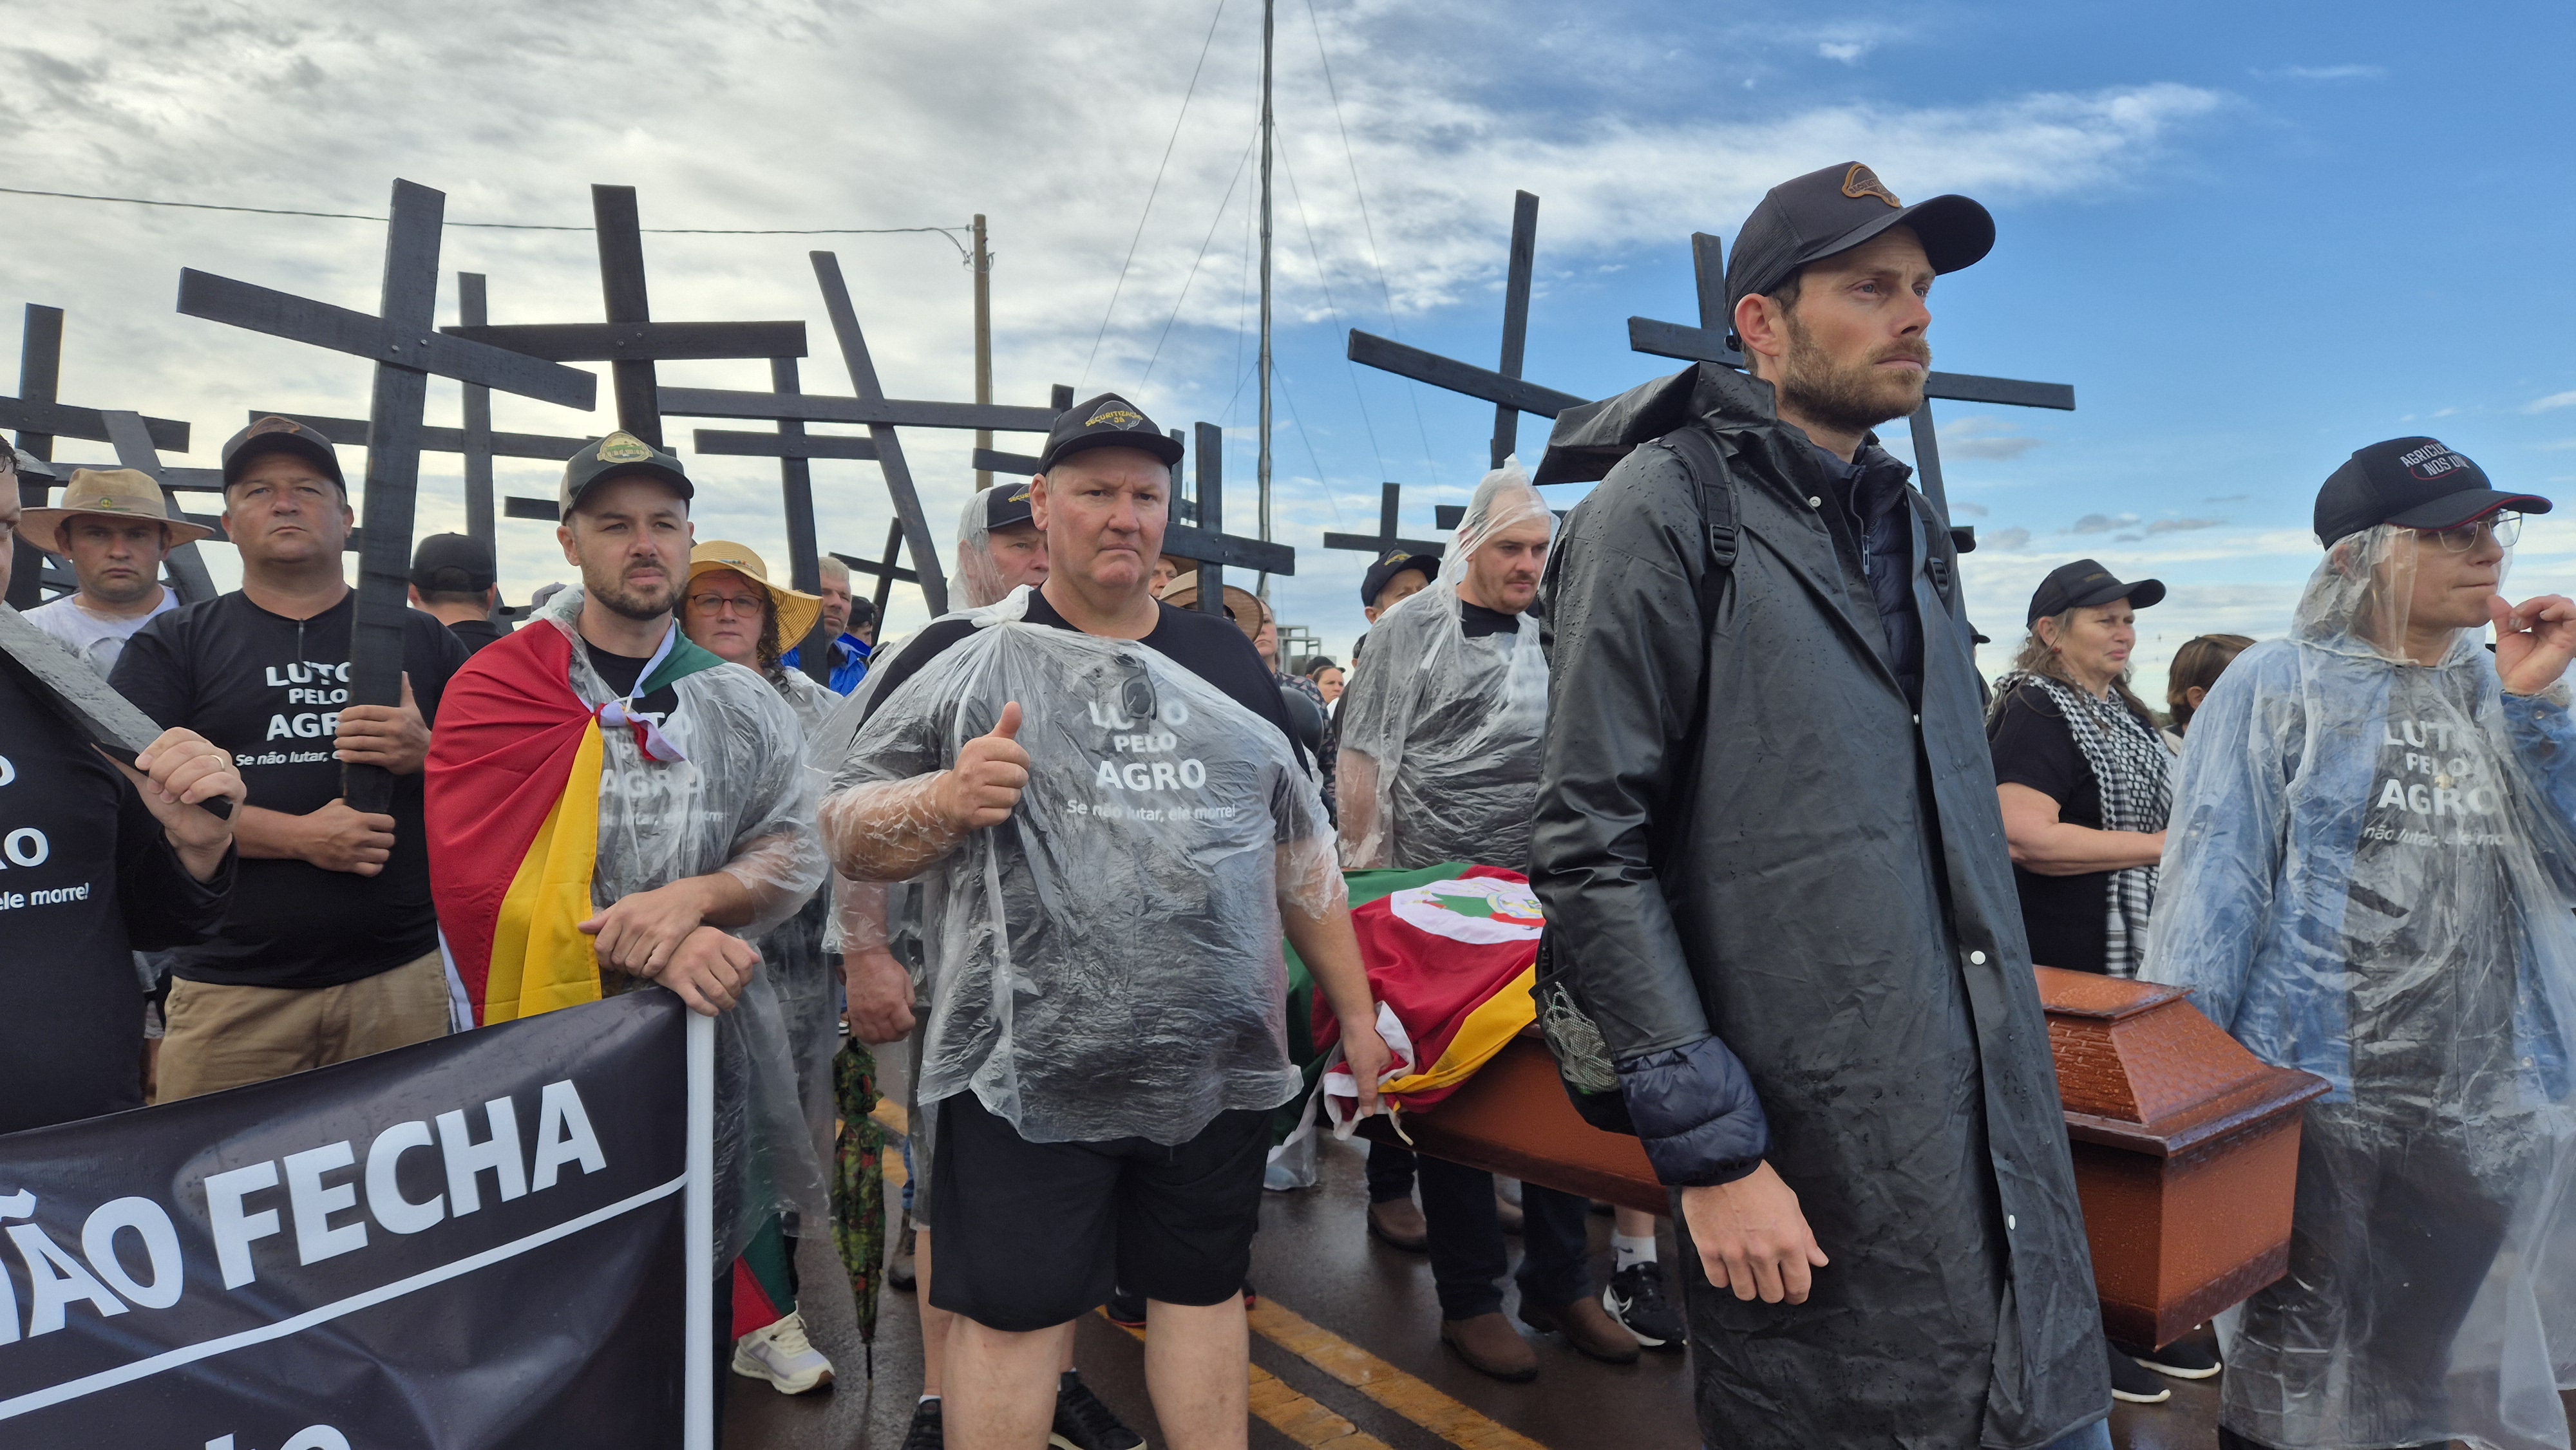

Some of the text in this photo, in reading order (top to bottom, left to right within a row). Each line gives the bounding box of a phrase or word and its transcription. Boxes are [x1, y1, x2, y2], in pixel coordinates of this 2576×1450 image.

[2422, 457, 2452, 476] NOS
[289, 688, 348, 705] PELO
[266, 712, 341, 741] AGR
[1088, 701, 1189, 730] LUO
[1113, 731, 1177, 753] PELO
[236, 754, 254, 767] Se
[257, 751, 287, 765] não
[1095, 758, 1206, 791] AGRO
[2377, 779, 2497, 816] AGRO
[1067, 800, 1088, 815] Se
[1093, 803, 1122, 818] não
[1168, 807, 1191, 822] ele
[2363, 824, 2395, 840] não
[31, 882, 90, 906] morre!
[204, 1078, 606, 1290] FECHA
